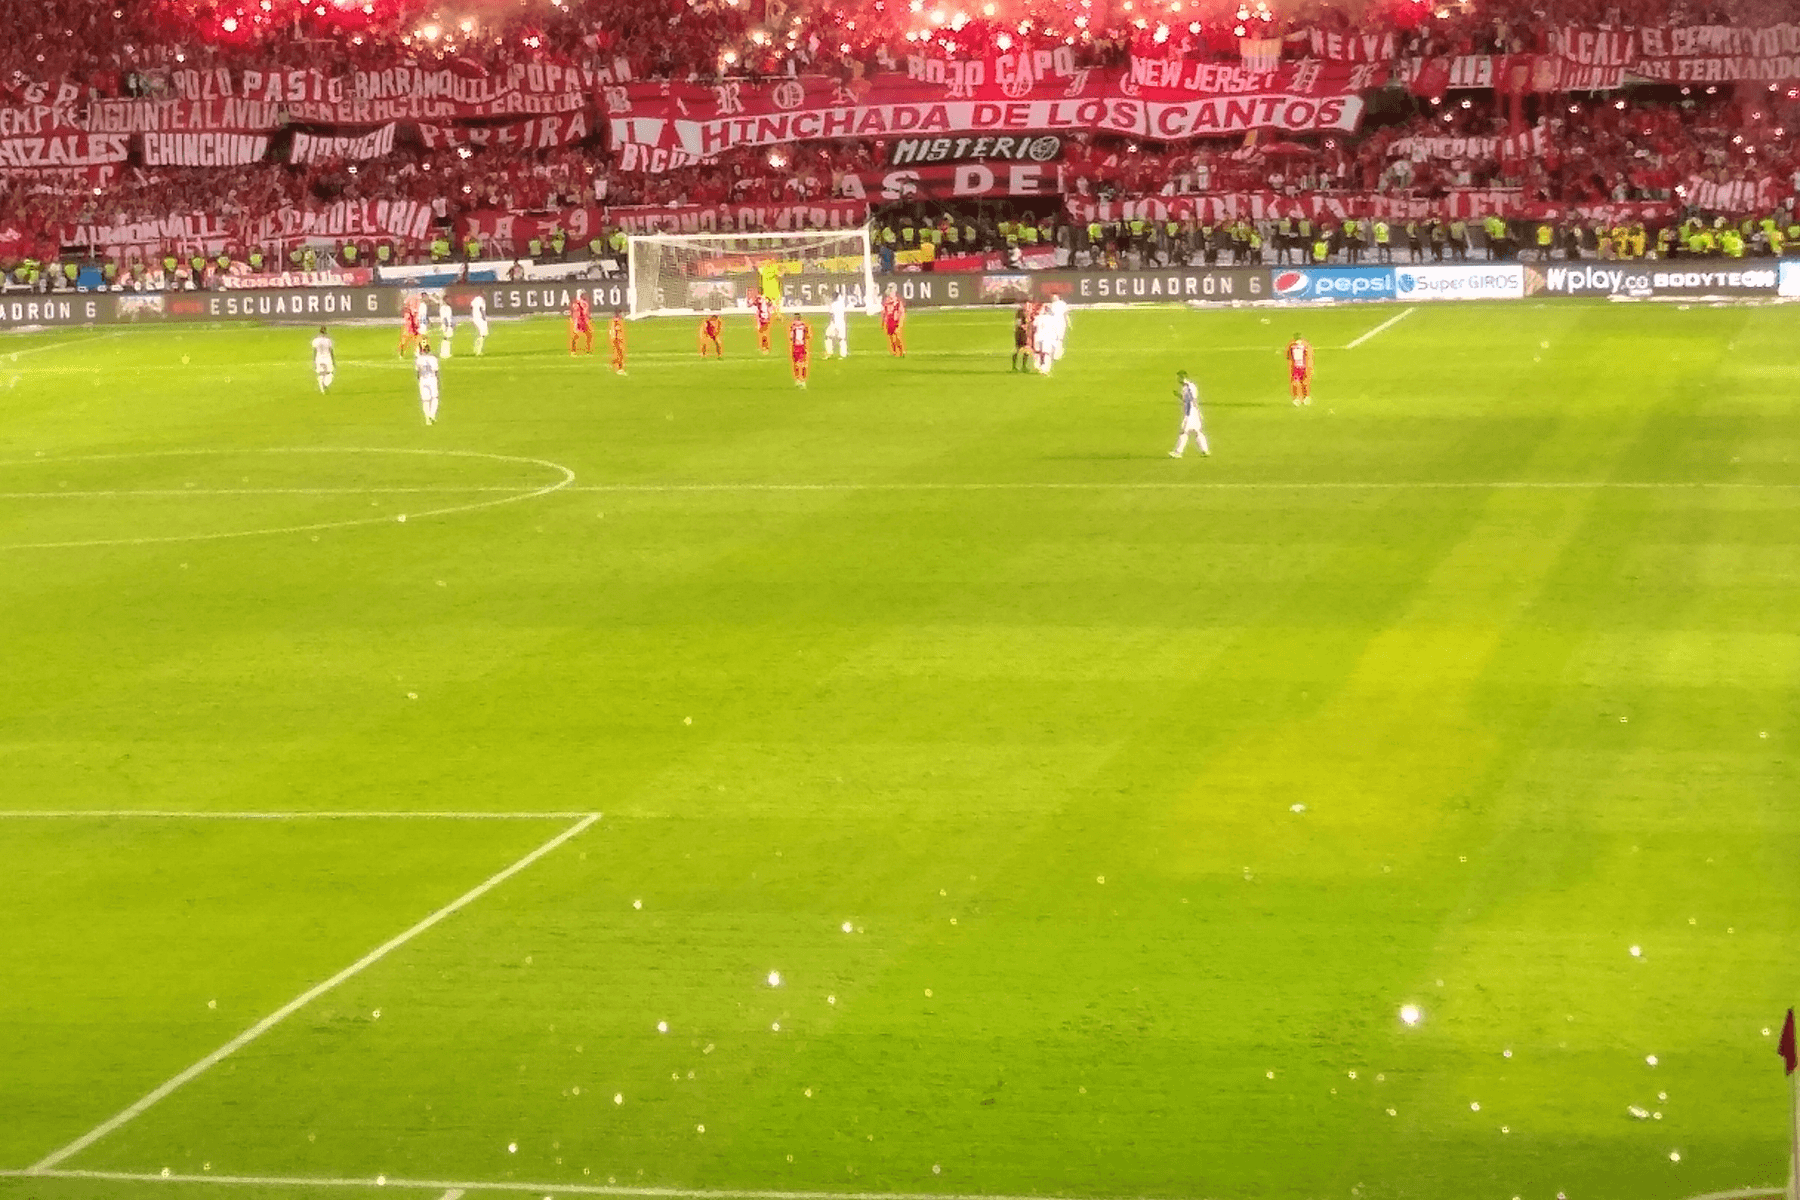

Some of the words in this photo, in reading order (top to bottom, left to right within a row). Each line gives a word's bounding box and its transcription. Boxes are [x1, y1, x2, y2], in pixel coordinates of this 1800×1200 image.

[243, 69, 343, 103] PASTO
[701, 104, 951, 150] HINCHADA
[971, 103, 1031, 129] DE
[1048, 100, 1138, 129] LOS
[1157, 97, 1346, 136] CANTOS
[948, 281, 960, 299] 6
[1080, 274, 1233, 297] ESCUADRÓN
[1249, 276, 1262, 294] 6
[1315, 273, 1391, 295] pepsi
[1417, 276, 1465, 292] Super
[85, 301, 96, 318] 6
[210, 291, 352, 315] ESCUADRÓN
[367, 293, 379, 311] 6
